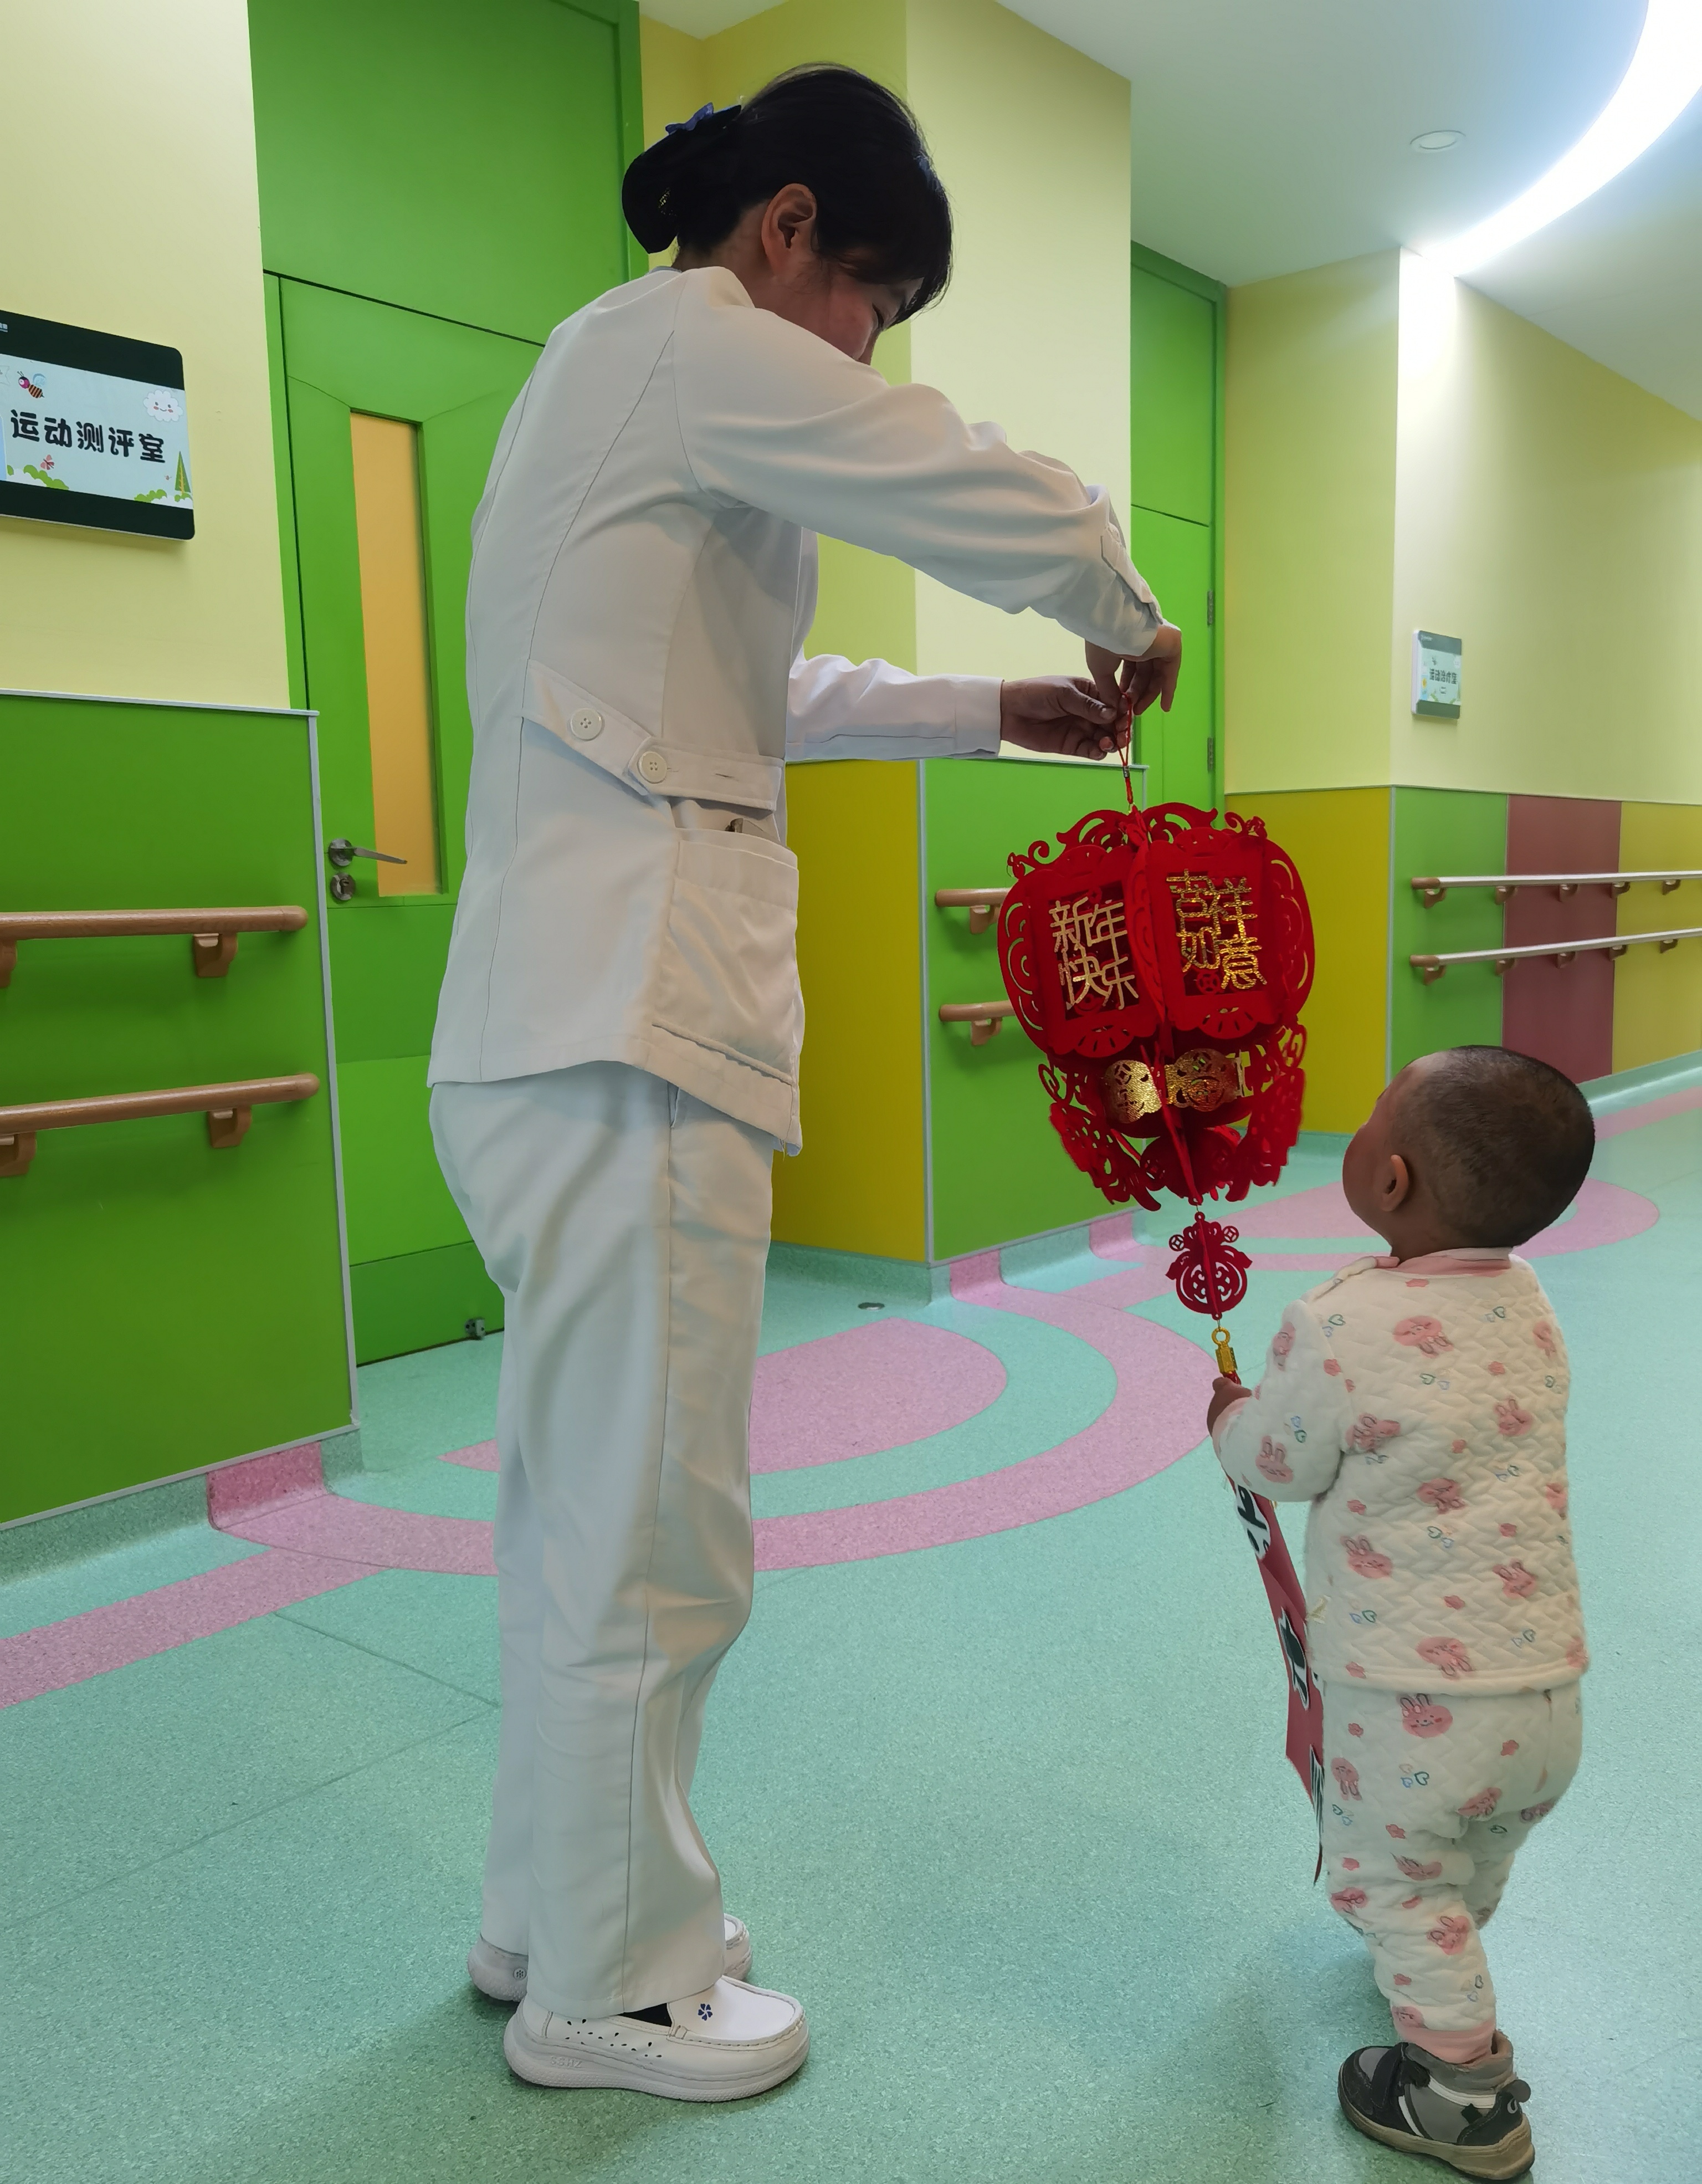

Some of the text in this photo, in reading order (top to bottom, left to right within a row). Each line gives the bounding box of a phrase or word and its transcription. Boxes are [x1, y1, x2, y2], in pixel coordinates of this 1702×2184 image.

[11, 409, 165, 464] 运动测评室
[1049, 896, 1128, 955] 新年
[1058, 944, 1139, 1010] 快乐
